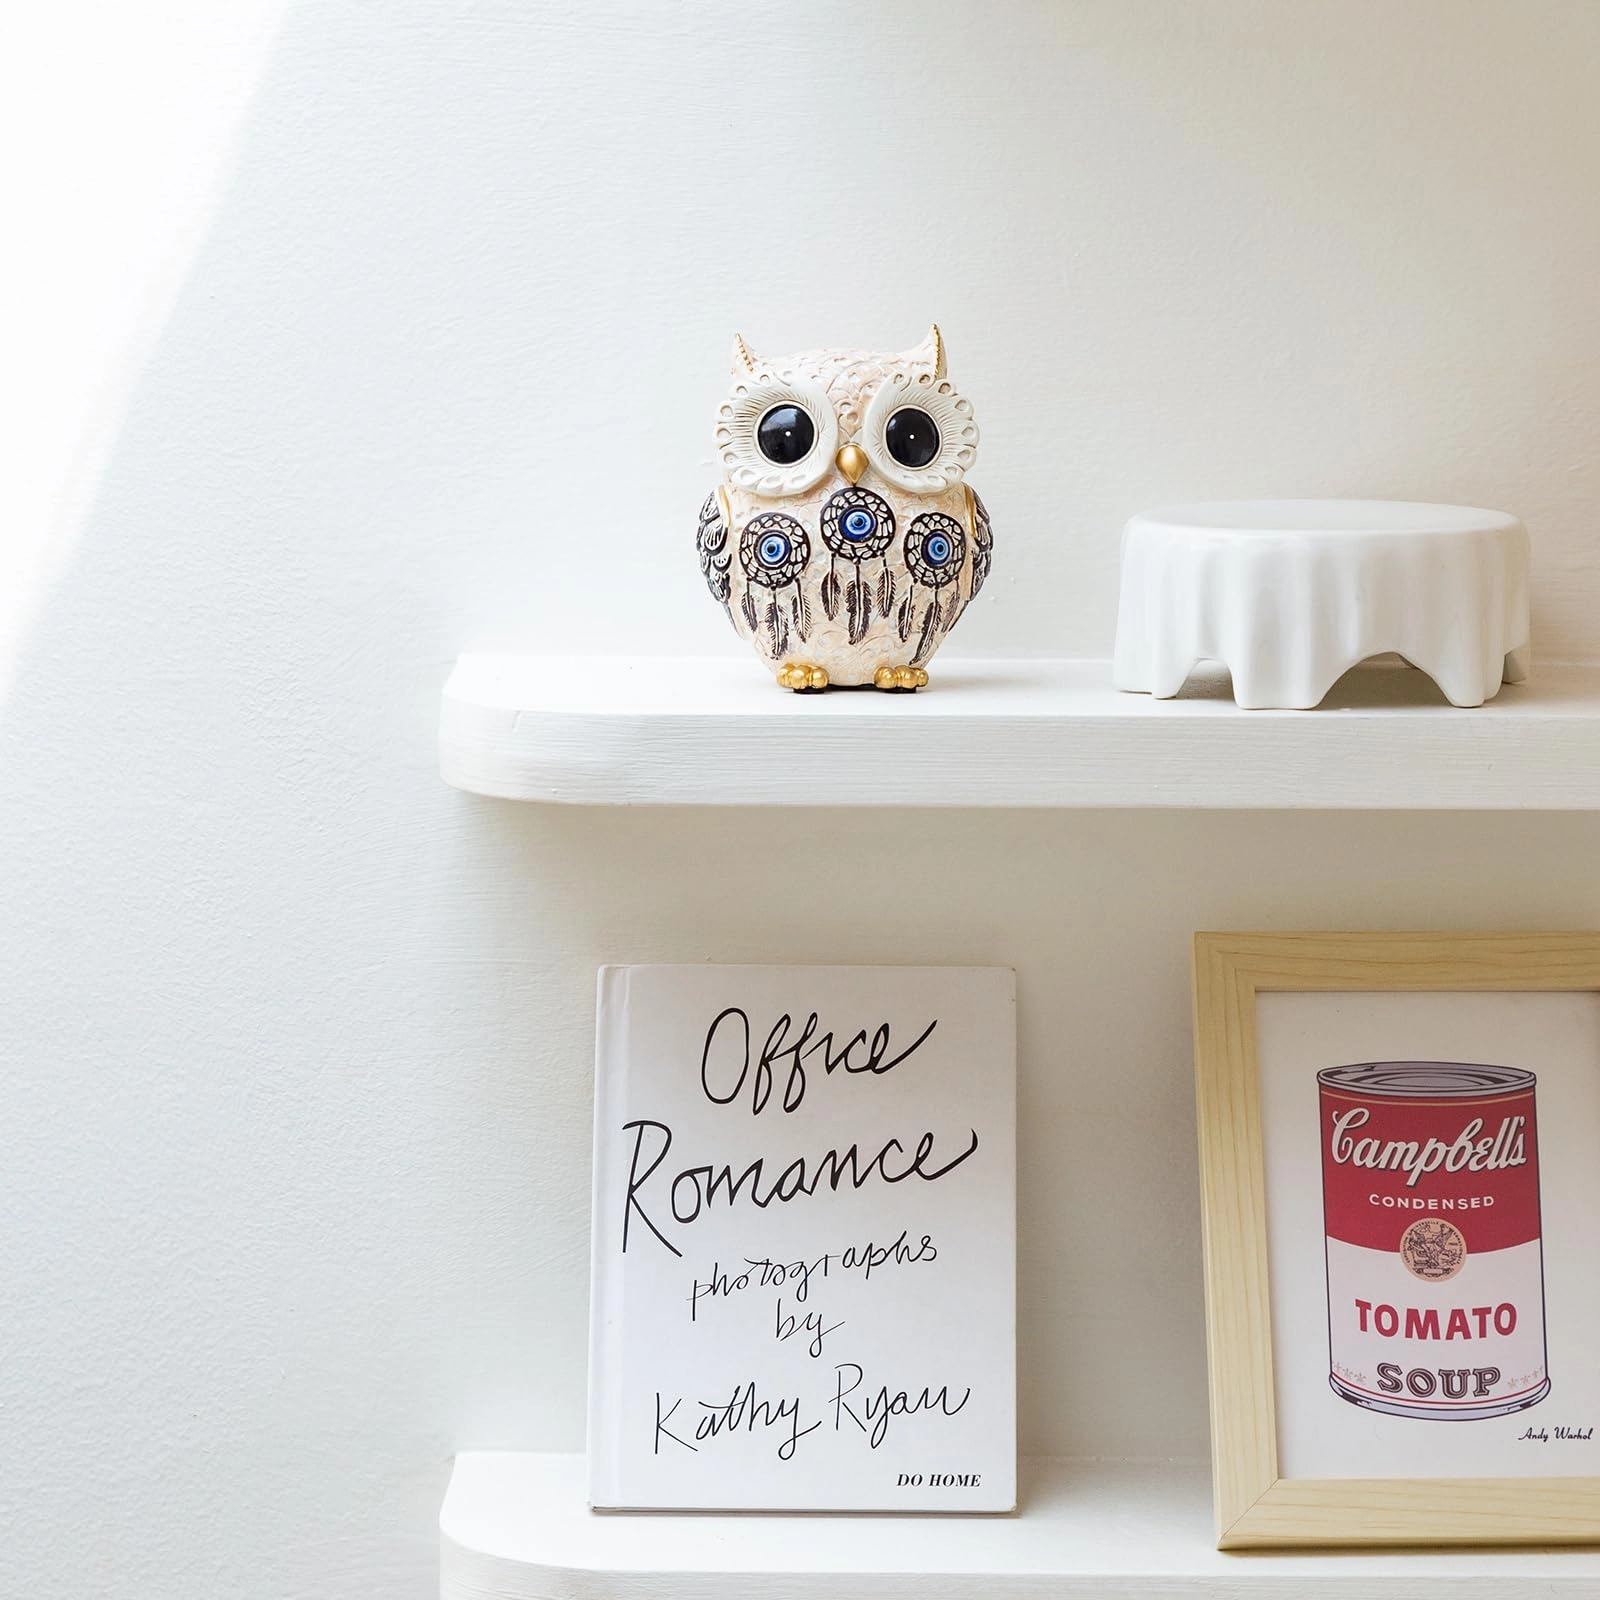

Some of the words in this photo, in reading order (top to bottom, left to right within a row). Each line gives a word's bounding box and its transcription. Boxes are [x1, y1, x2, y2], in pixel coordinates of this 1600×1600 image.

[701, 1007, 938, 1115] Office
[1331, 1107, 1526, 1186] Campbell's
[622, 1120, 979, 1257] Romance
[1369, 1193, 1495, 1211] CONDENSED
[686, 1230, 938, 1321] photographs
[776, 1298, 846, 1357] by
[1355, 1298, 1518, 1340] TOMATO
[1376, 1362, 1501, 1399] SOUP
[654, 1381, 822, 1460] Kathy
[829, 1363, 971, 1449] Ryan
[1518, 1427, 1549, 1442] Andy
[1554, 1427, 1594, 1440] Warhol
[896, 1473, 923, 1488] DO
[929, 1473, 982, 1488] HOME
